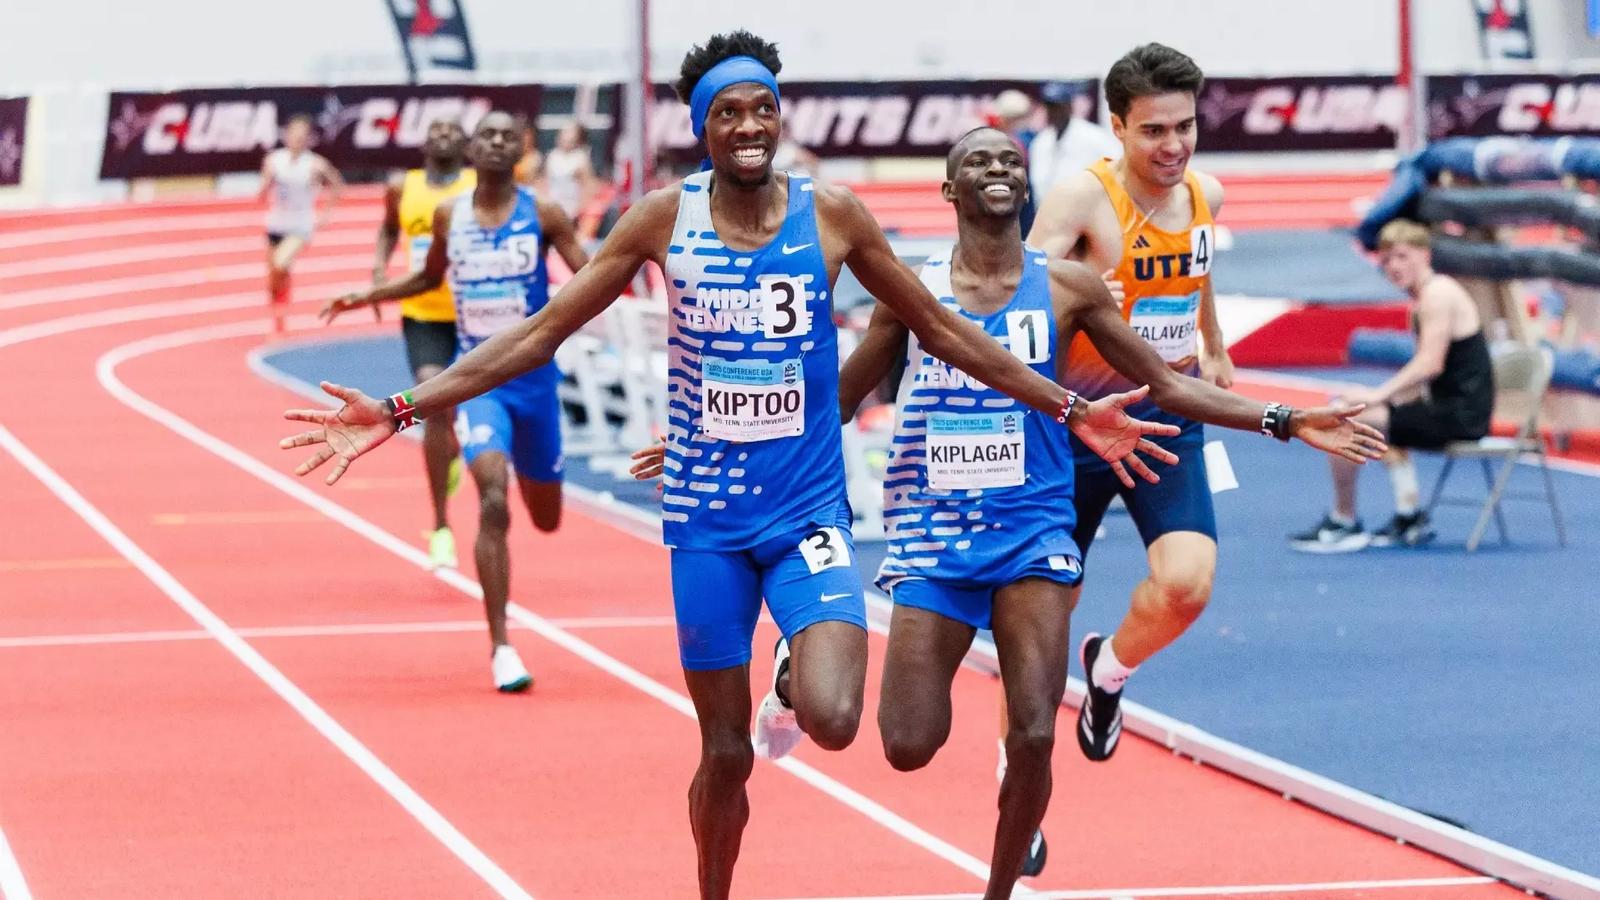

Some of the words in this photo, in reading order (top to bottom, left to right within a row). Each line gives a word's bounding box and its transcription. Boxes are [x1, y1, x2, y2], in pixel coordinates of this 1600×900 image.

[516, 240, 530, 270] 5
[1195, 229, 1209, 272] 4
[1133, 252, 1193, 281] UTE
[696, 287, 763, 310] MIDD
[770, 281, 797, 335] 3
[1018, 314, 1036, 360] 1
[723, 366, 760, 376] CONFERENCE
[707, 388, 801, 417] KIPTOO
[761, 415, 794, 425] UNIVERSITY
[930, 442, 1021, 463] KIPLAGAT
[805, 530, 840, 567] 3
